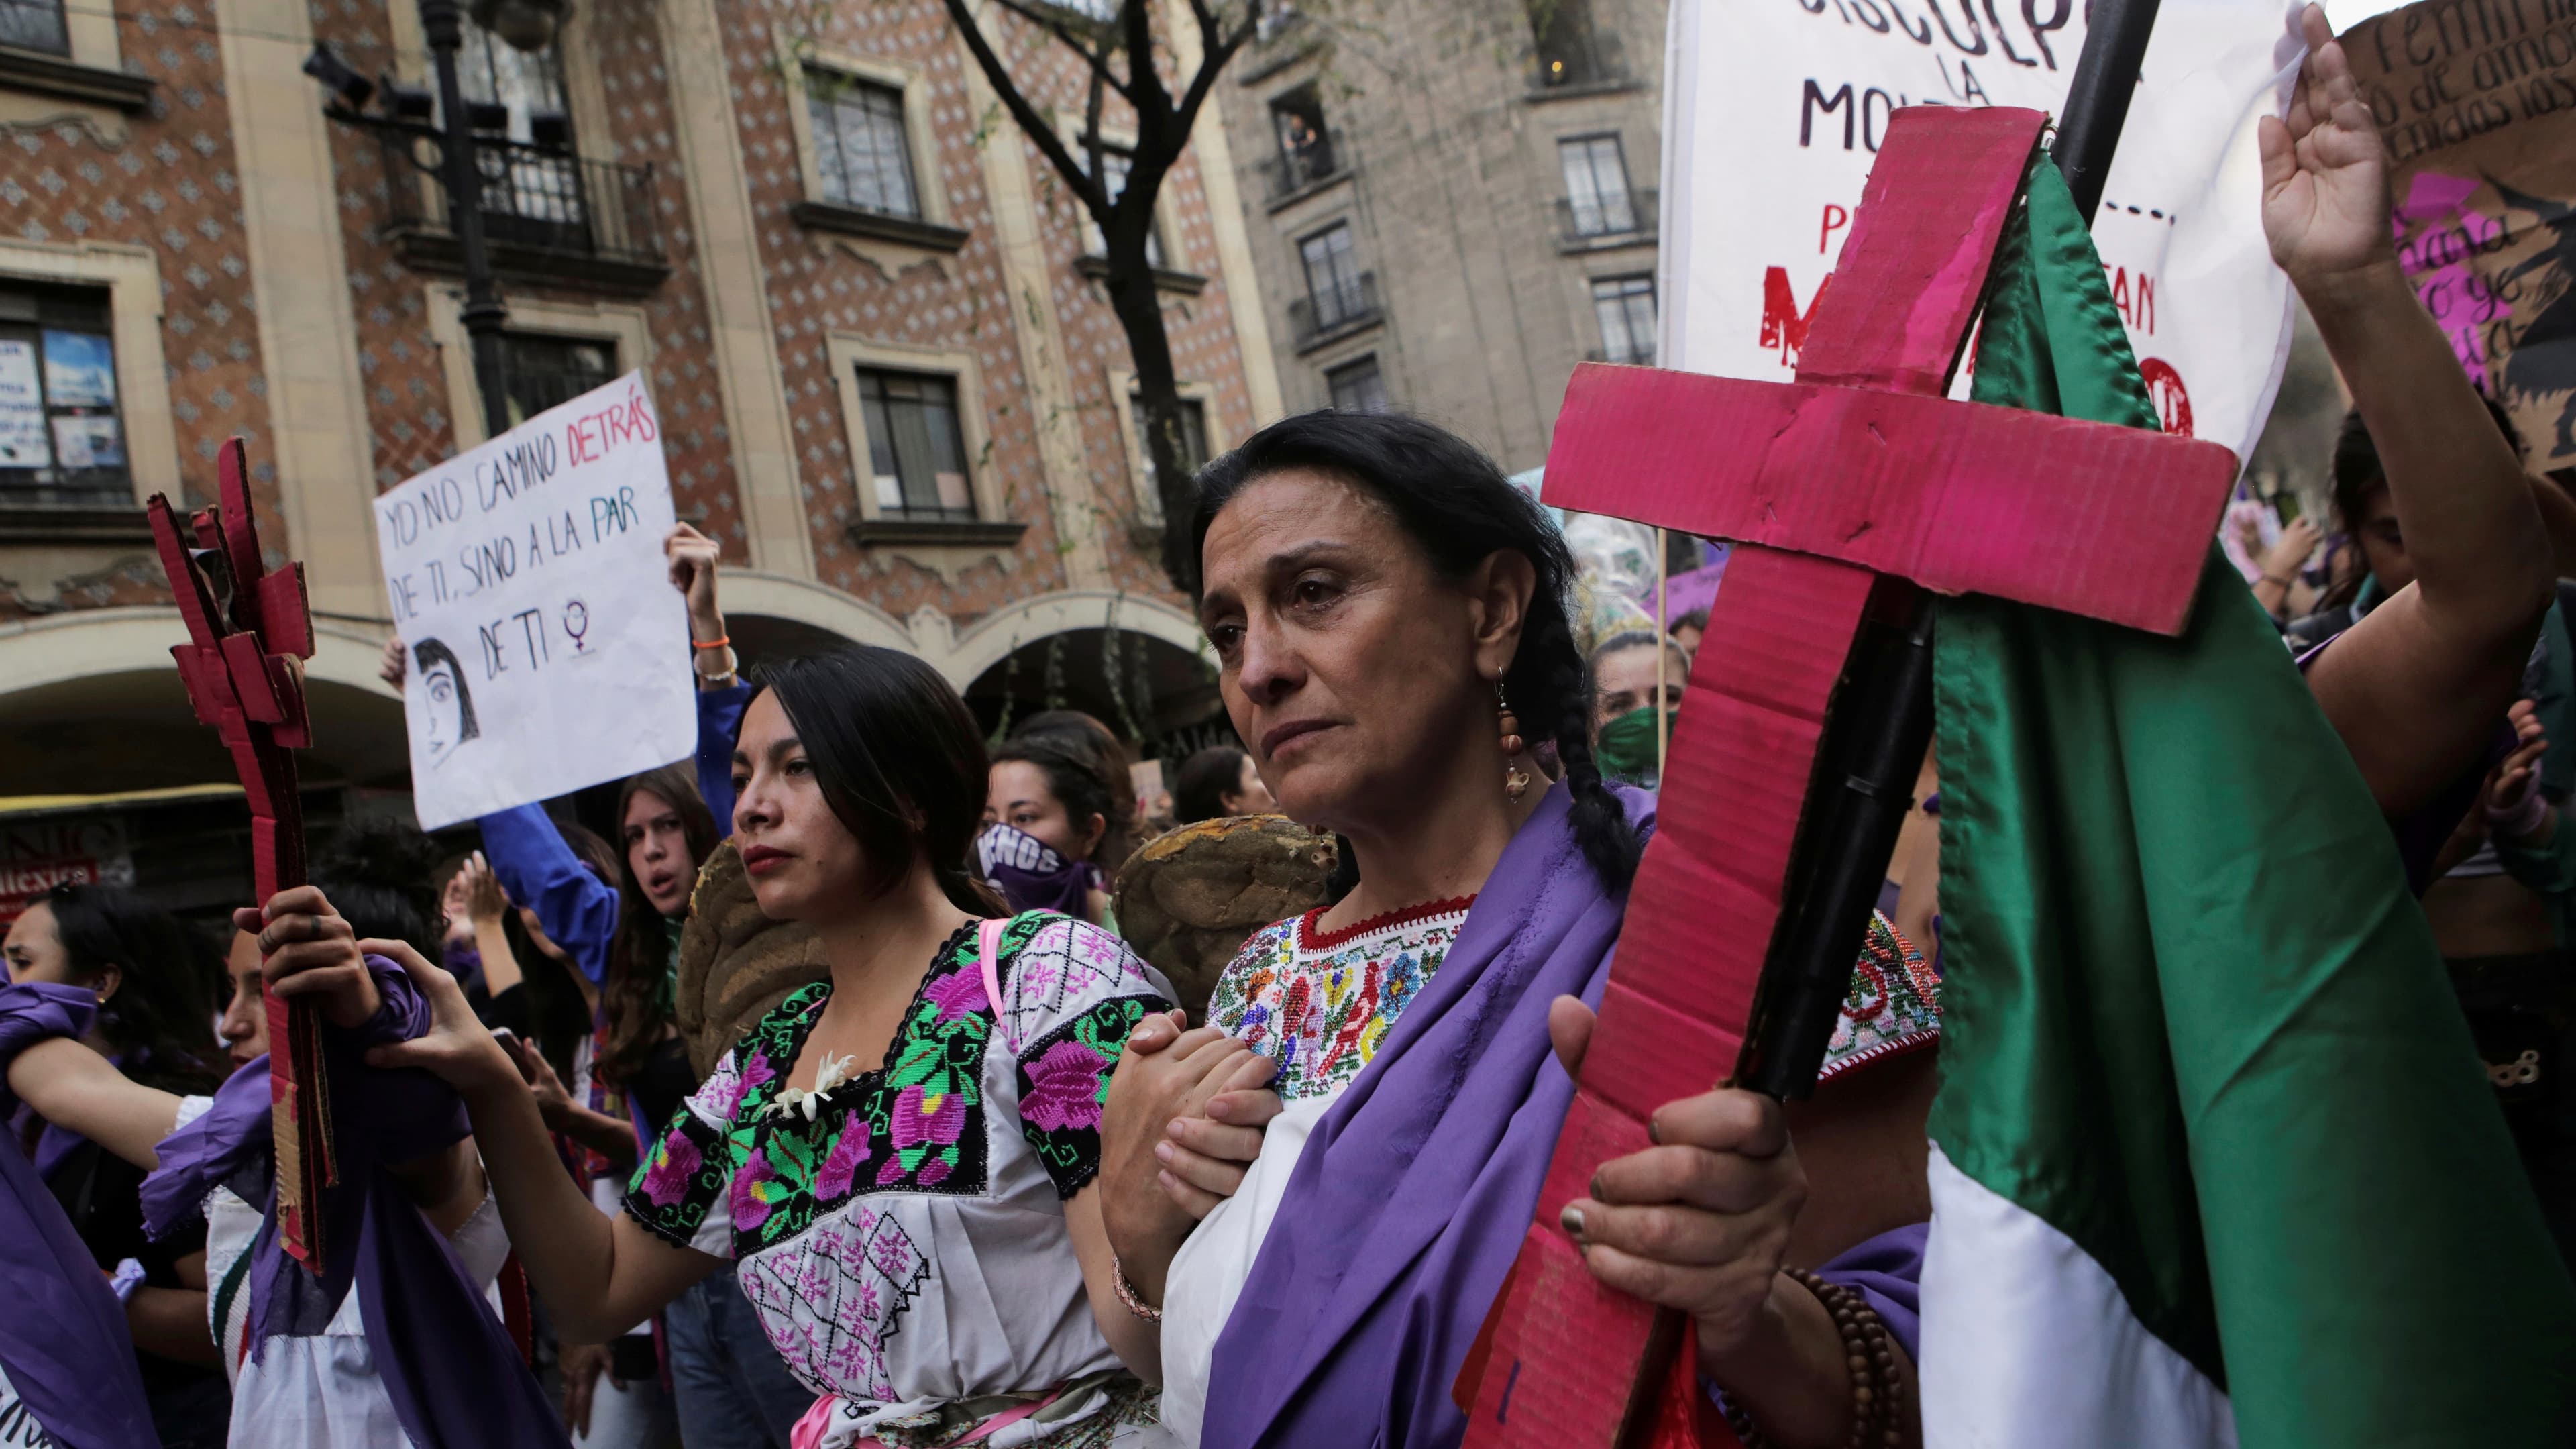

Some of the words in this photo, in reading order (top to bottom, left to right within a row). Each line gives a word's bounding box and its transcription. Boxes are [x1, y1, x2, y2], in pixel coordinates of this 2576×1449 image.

[1936, 53, 1994, 106] LA
[2410, 64, 2461, 113] de
[385, 500, 419, 550] YO
[421, 477, 463, 530] NO
[475, 433, 557, 513] CAMINO
[567, 384, 655, 467] DETRÁS
[390, 574, 419, 623] DE
[460, 535, 515, 597] SINO
[529, 521, 543, 568] A
[547, 510, 582, 556] LA
[590, 486, 639, 544] PAR
[478, 619, 508, 681] DE
[512, 607, 549, 671] TI
